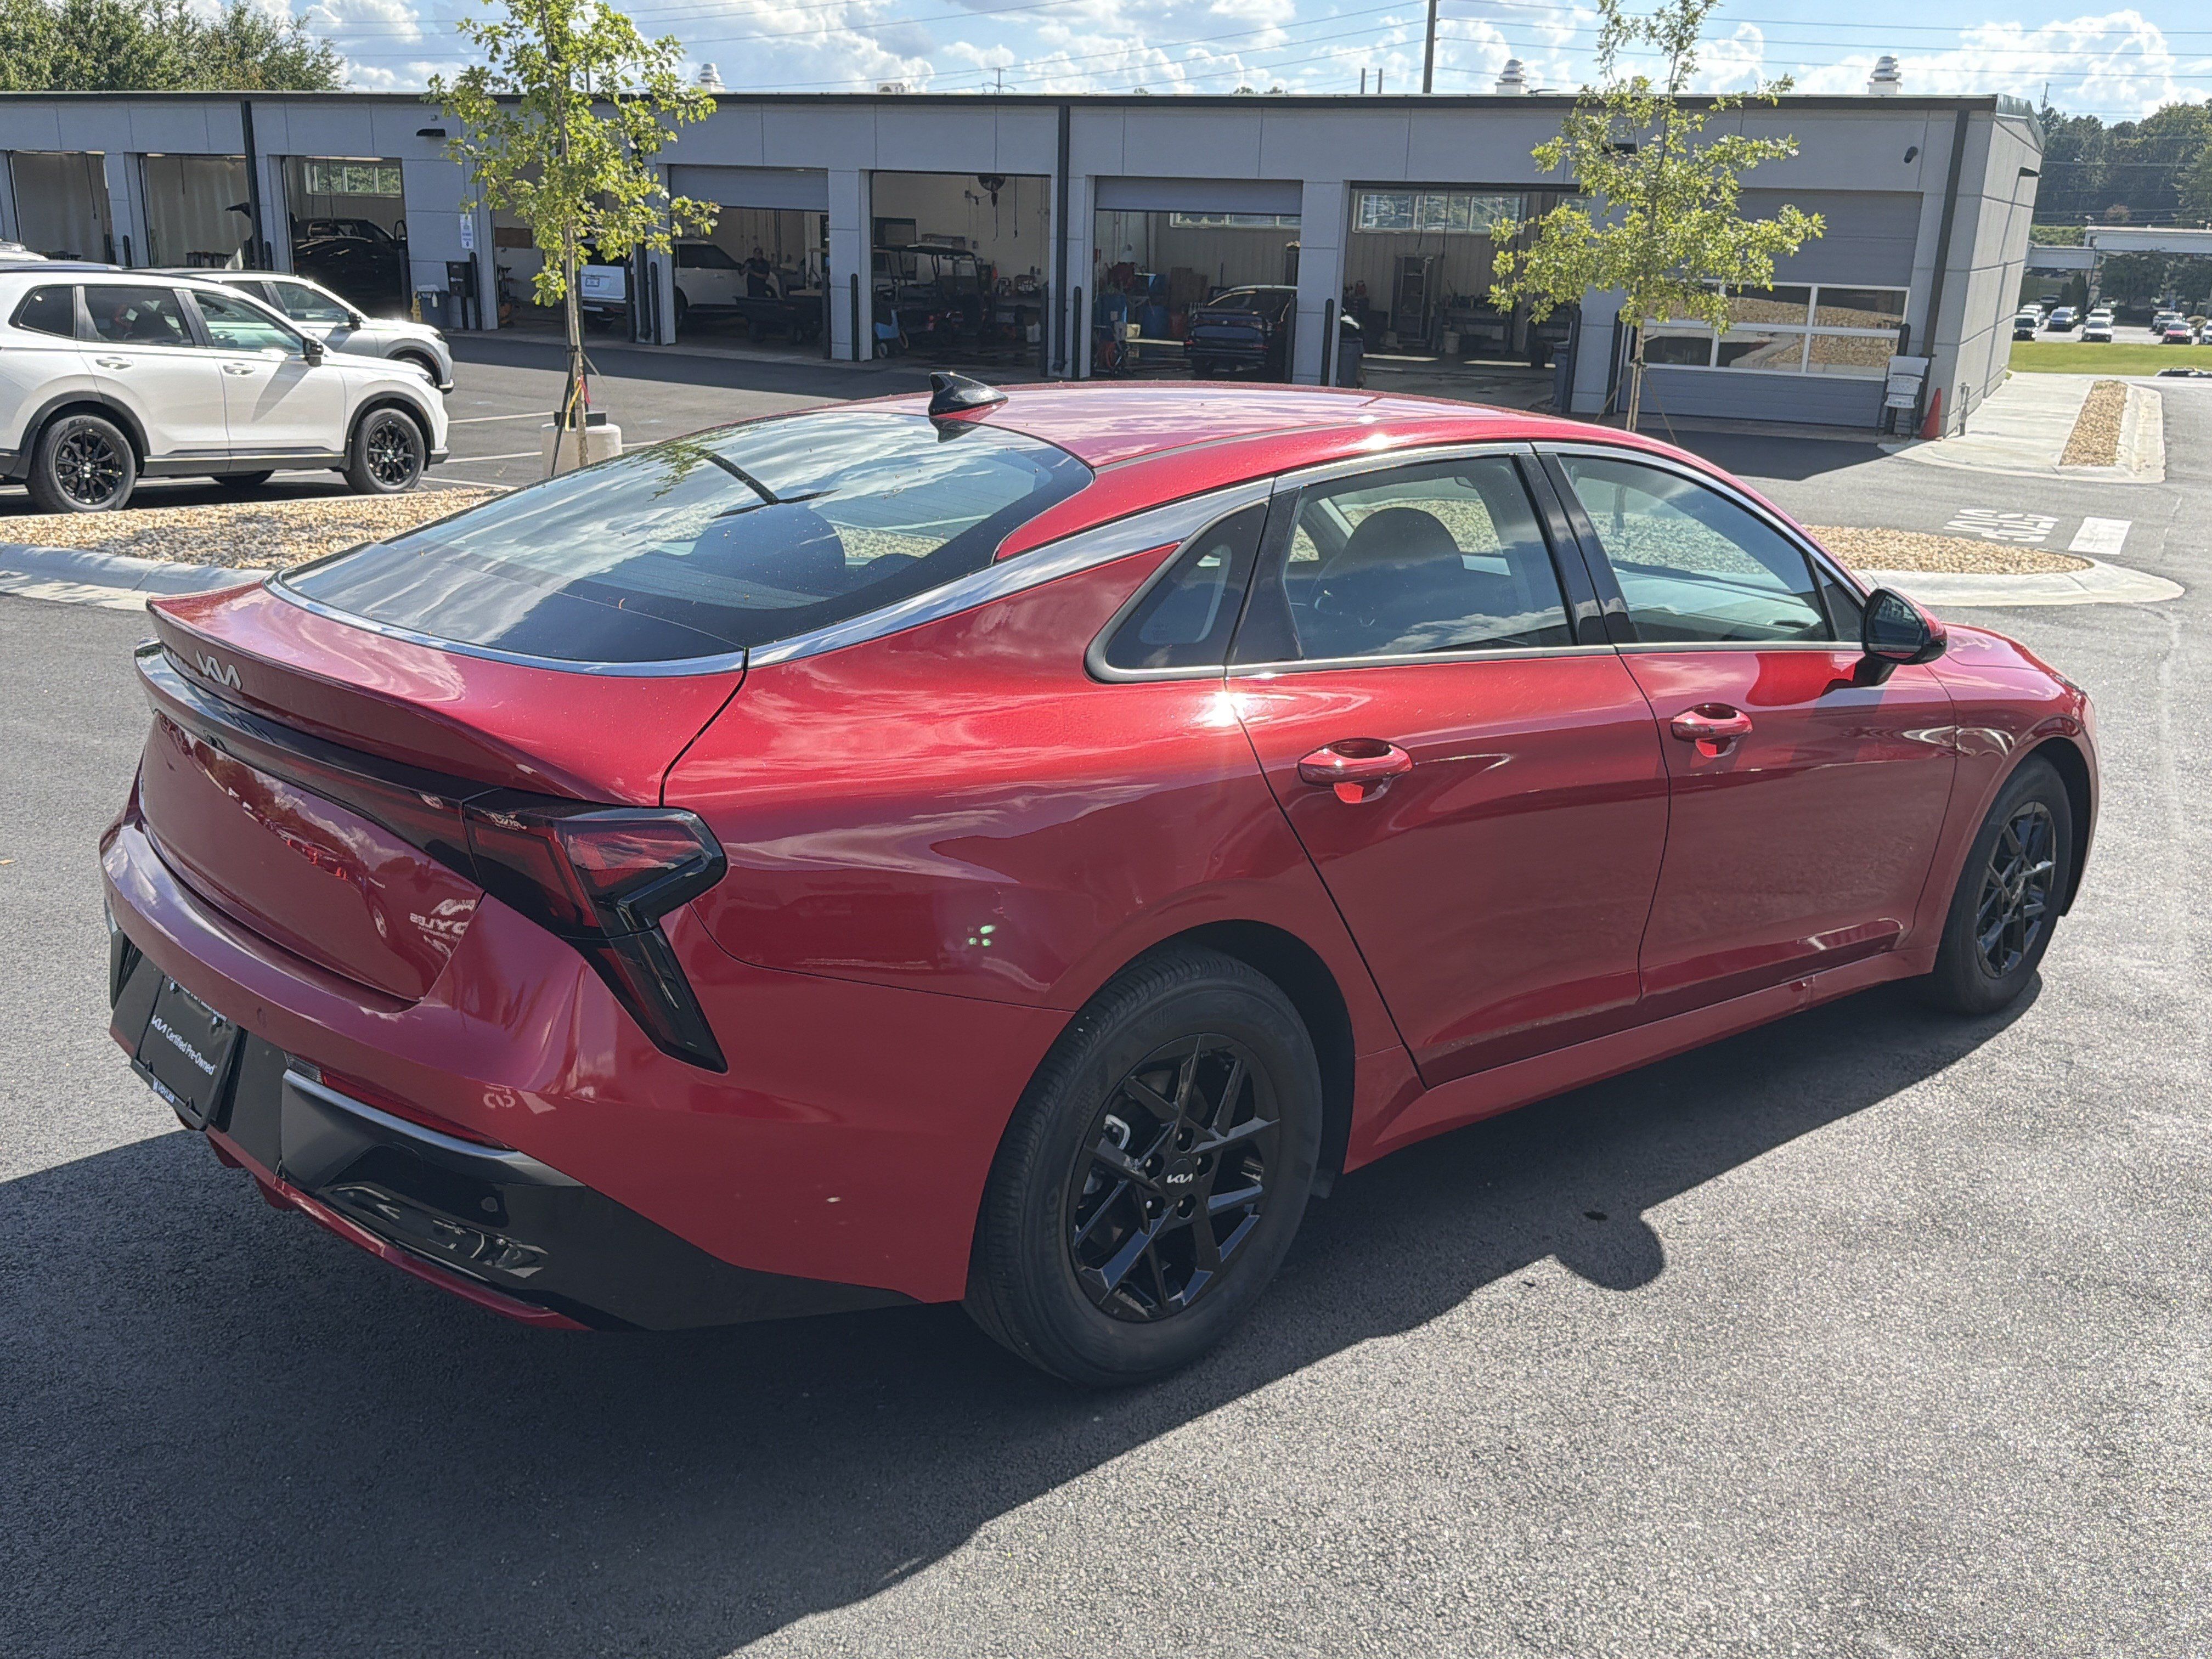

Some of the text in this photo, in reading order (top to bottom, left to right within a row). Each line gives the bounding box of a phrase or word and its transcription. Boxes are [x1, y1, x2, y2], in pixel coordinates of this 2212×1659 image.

[196, 650, 242, 691] KIA
[151, 1014, 216, 1076] KIA Certified Pre-Owned
[1166, 1173, 1193, 1183] KIA
